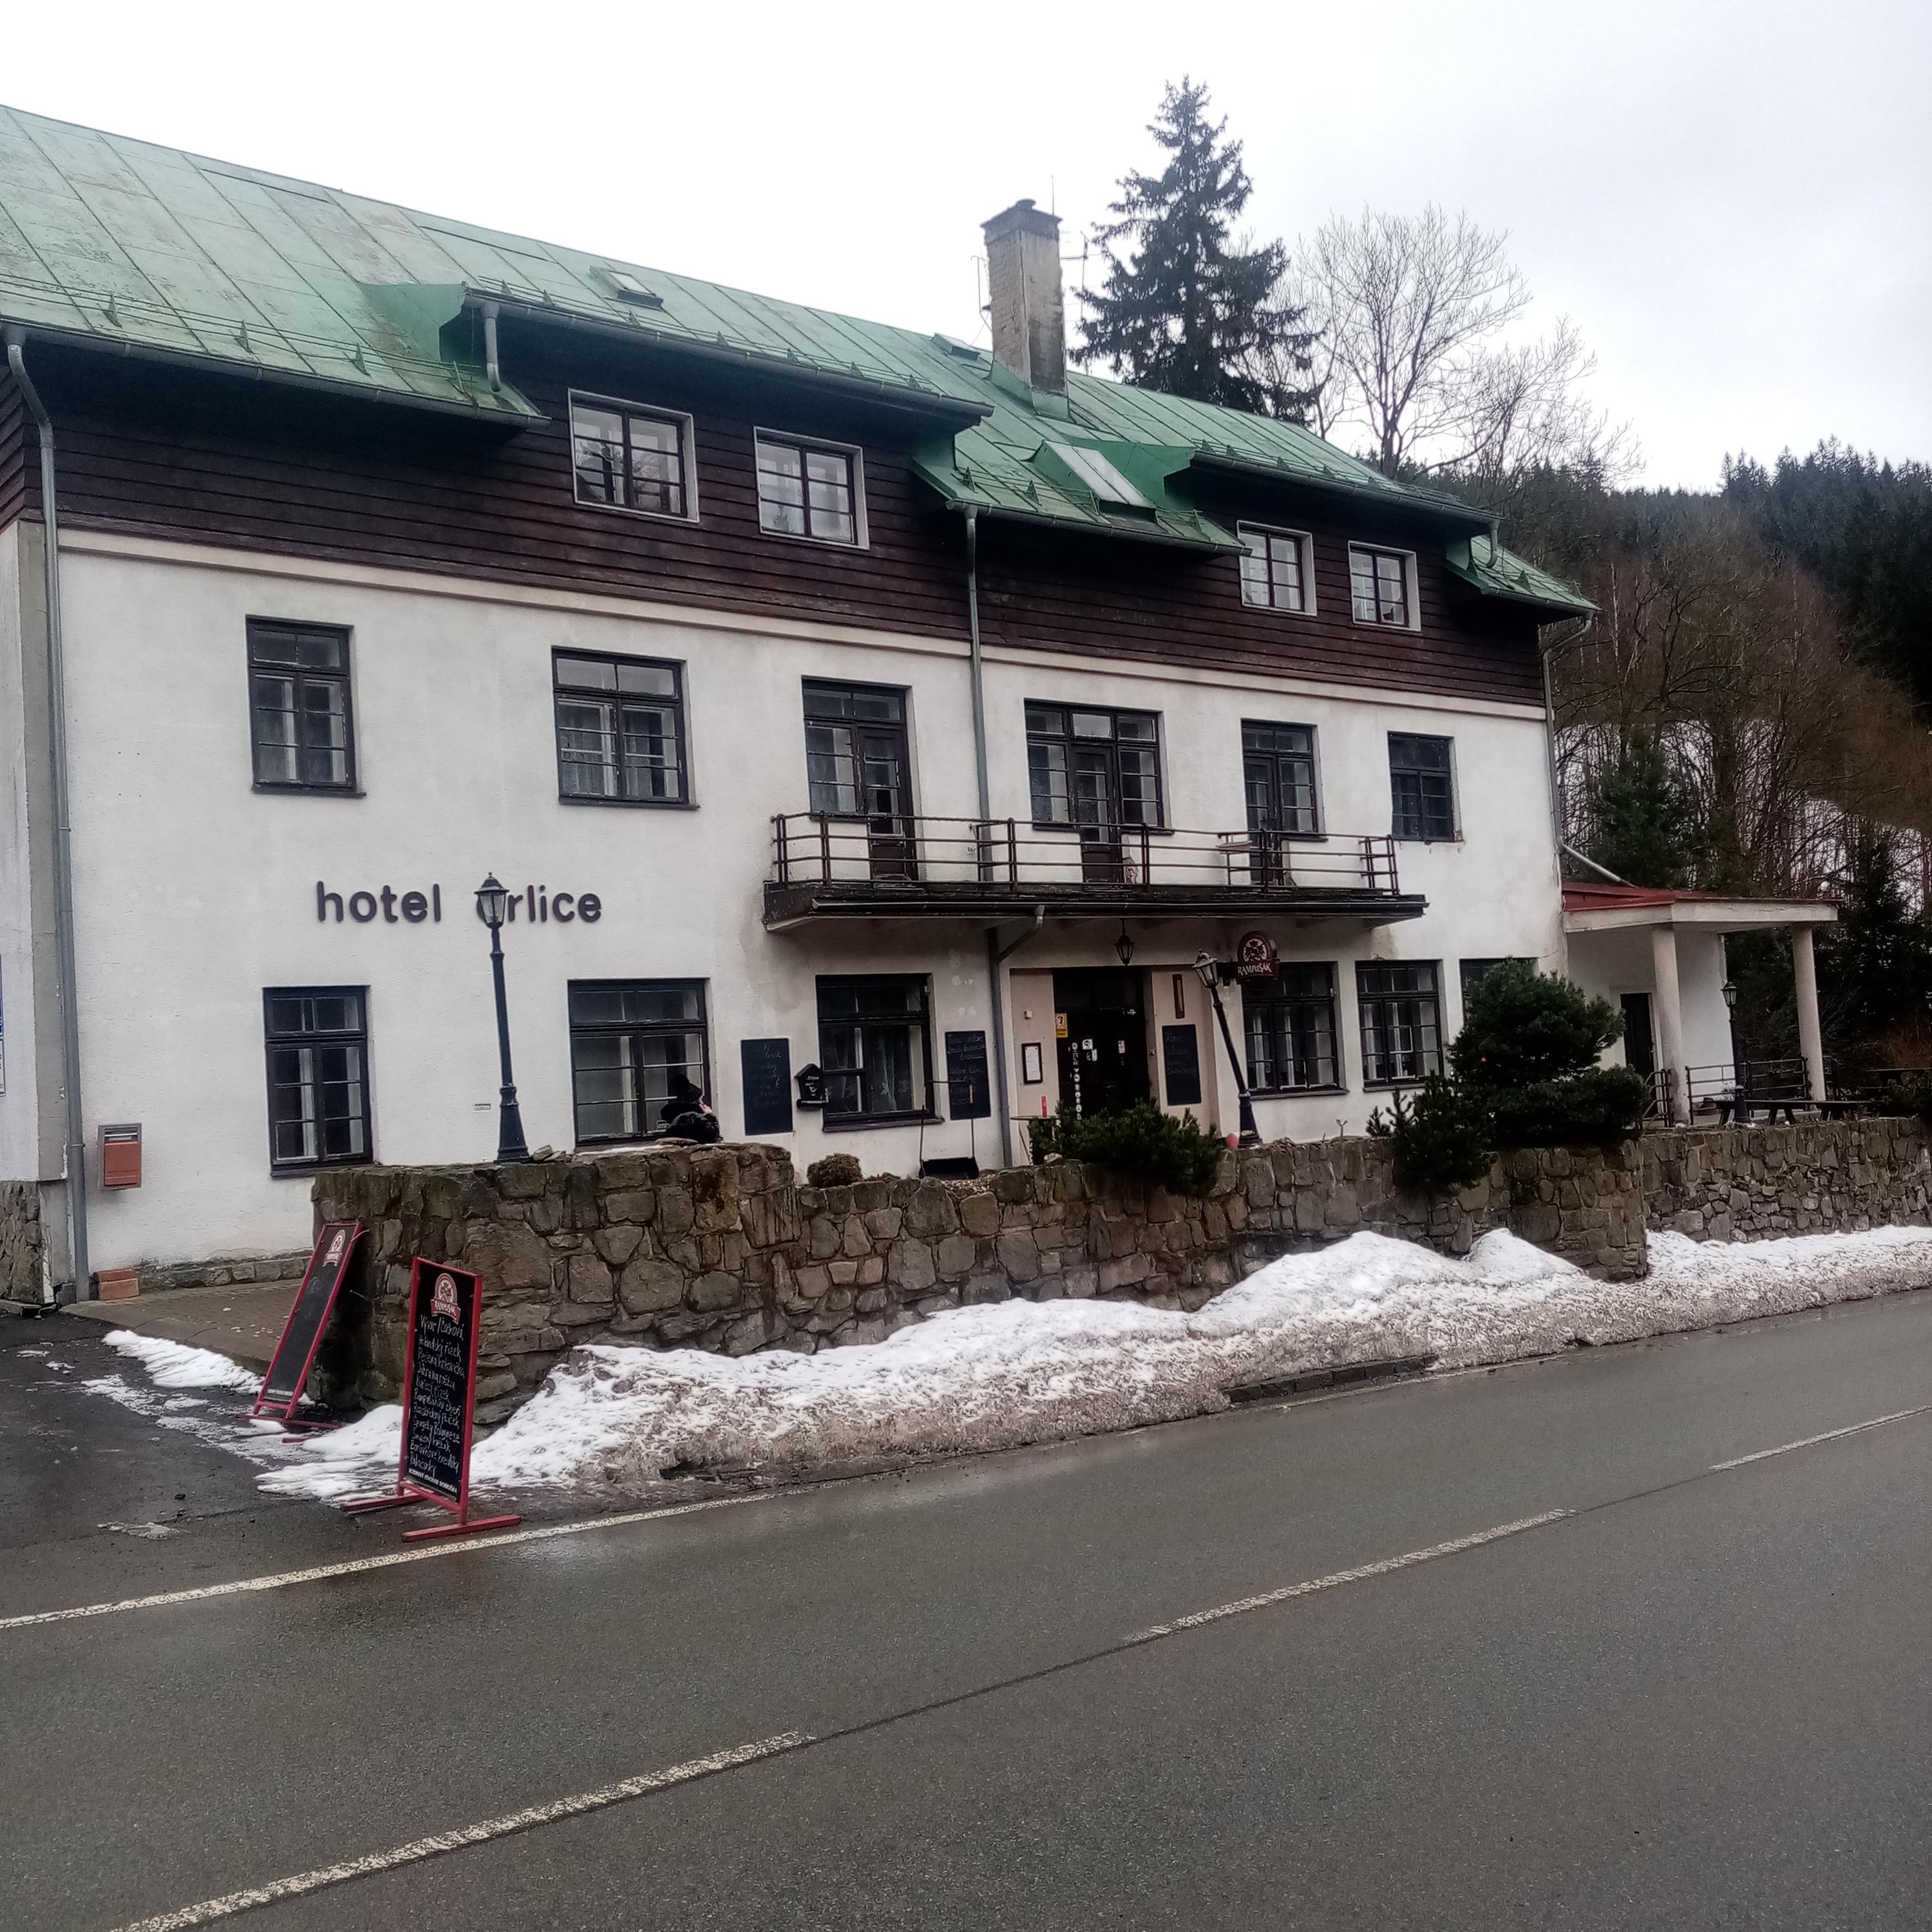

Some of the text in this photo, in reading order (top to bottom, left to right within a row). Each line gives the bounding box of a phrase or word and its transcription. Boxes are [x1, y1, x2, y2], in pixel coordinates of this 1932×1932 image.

[316, 880, 602, 923] hotel rlice
[1238, 962, 1273, 976] RAMPUŠÁK
